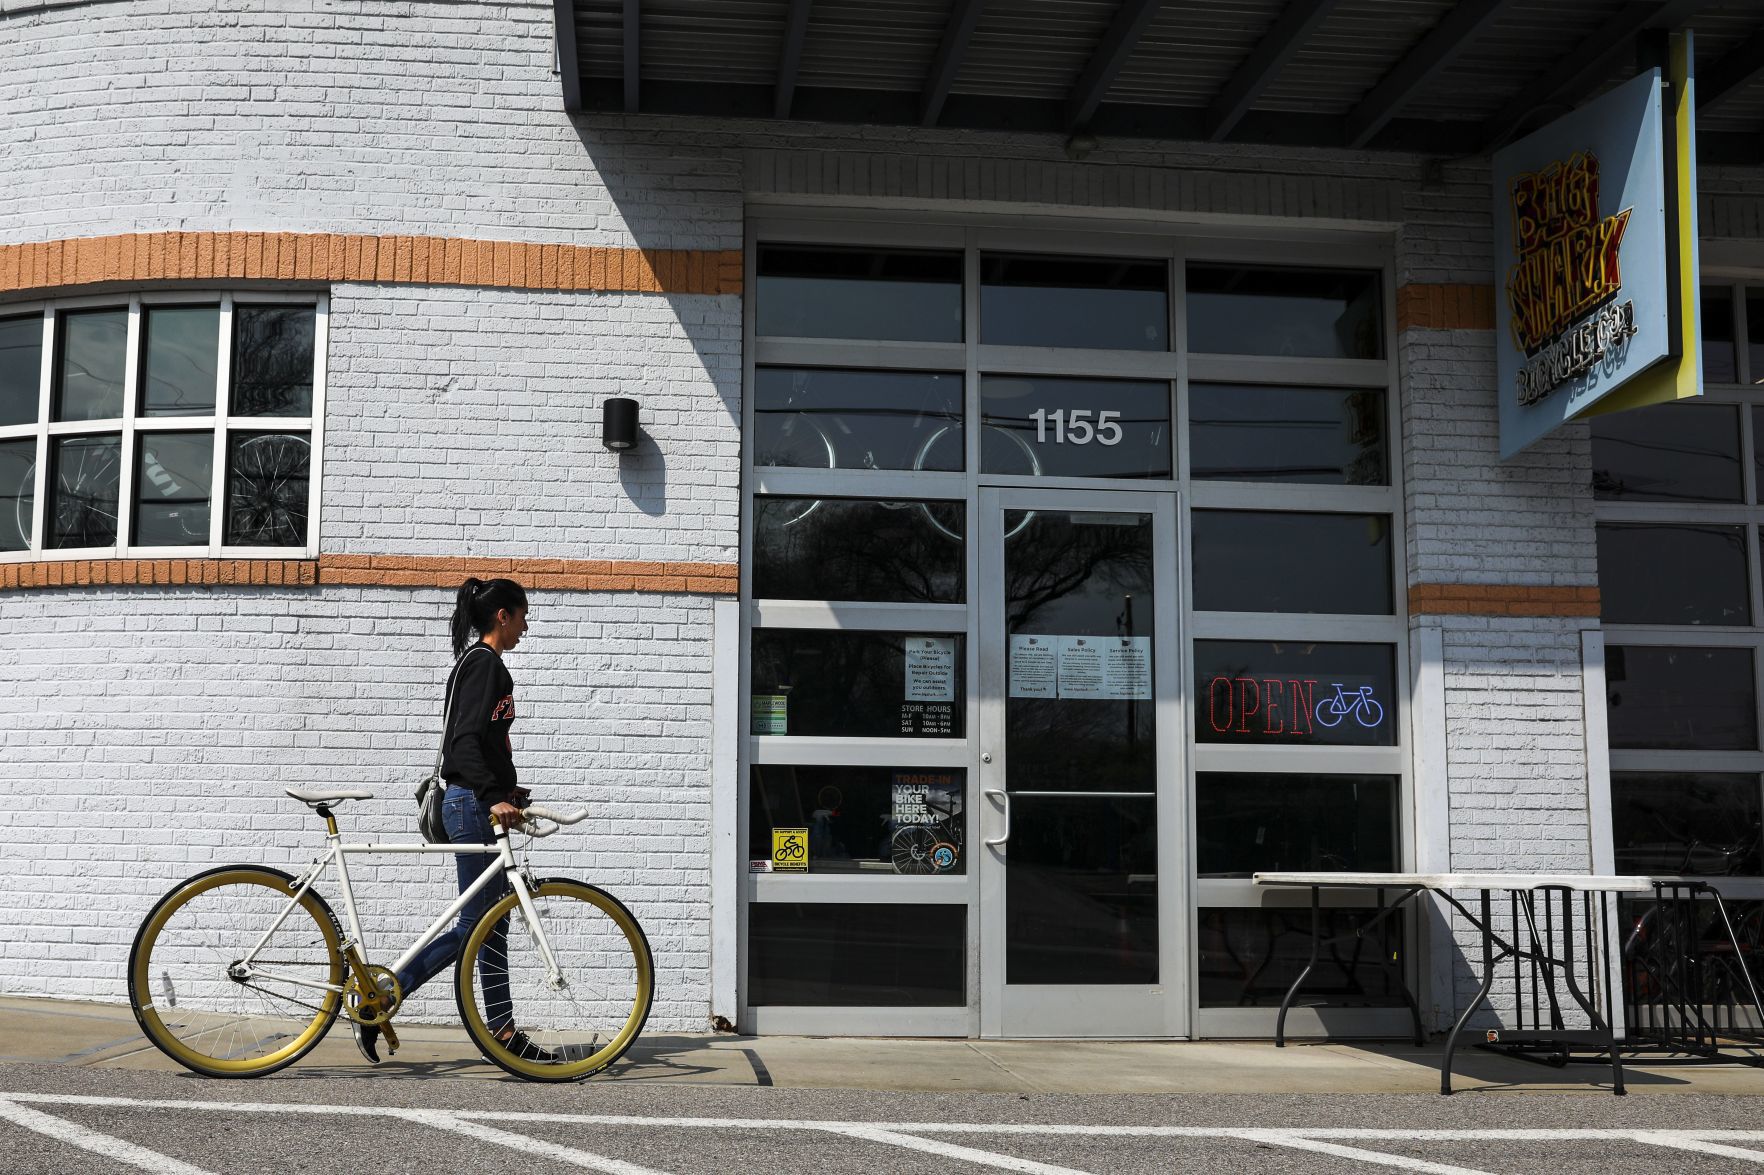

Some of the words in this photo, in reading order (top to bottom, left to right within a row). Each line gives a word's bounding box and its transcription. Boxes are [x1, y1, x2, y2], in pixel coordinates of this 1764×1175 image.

[1508, 149, 1601, 257] BIG
[1505, 209, 1632, 360] SHARK
[1515, 322, 1597, 407] BICYCLE
[1029, 408, 1123, 446] 1155
[901, 704, 924, 712] STORE
[926, 705, 951, 713] HOURS
[1210, 677, 1319, 735] OPEN
[895, 775, 951, 785] TRADE-IN
[895, 785, 929, 794] YOUR
[895, 794, 923, 804] BIKE
[895, 804, 927, 814] HERE
[895, 814, 939, 823] TODAY!
